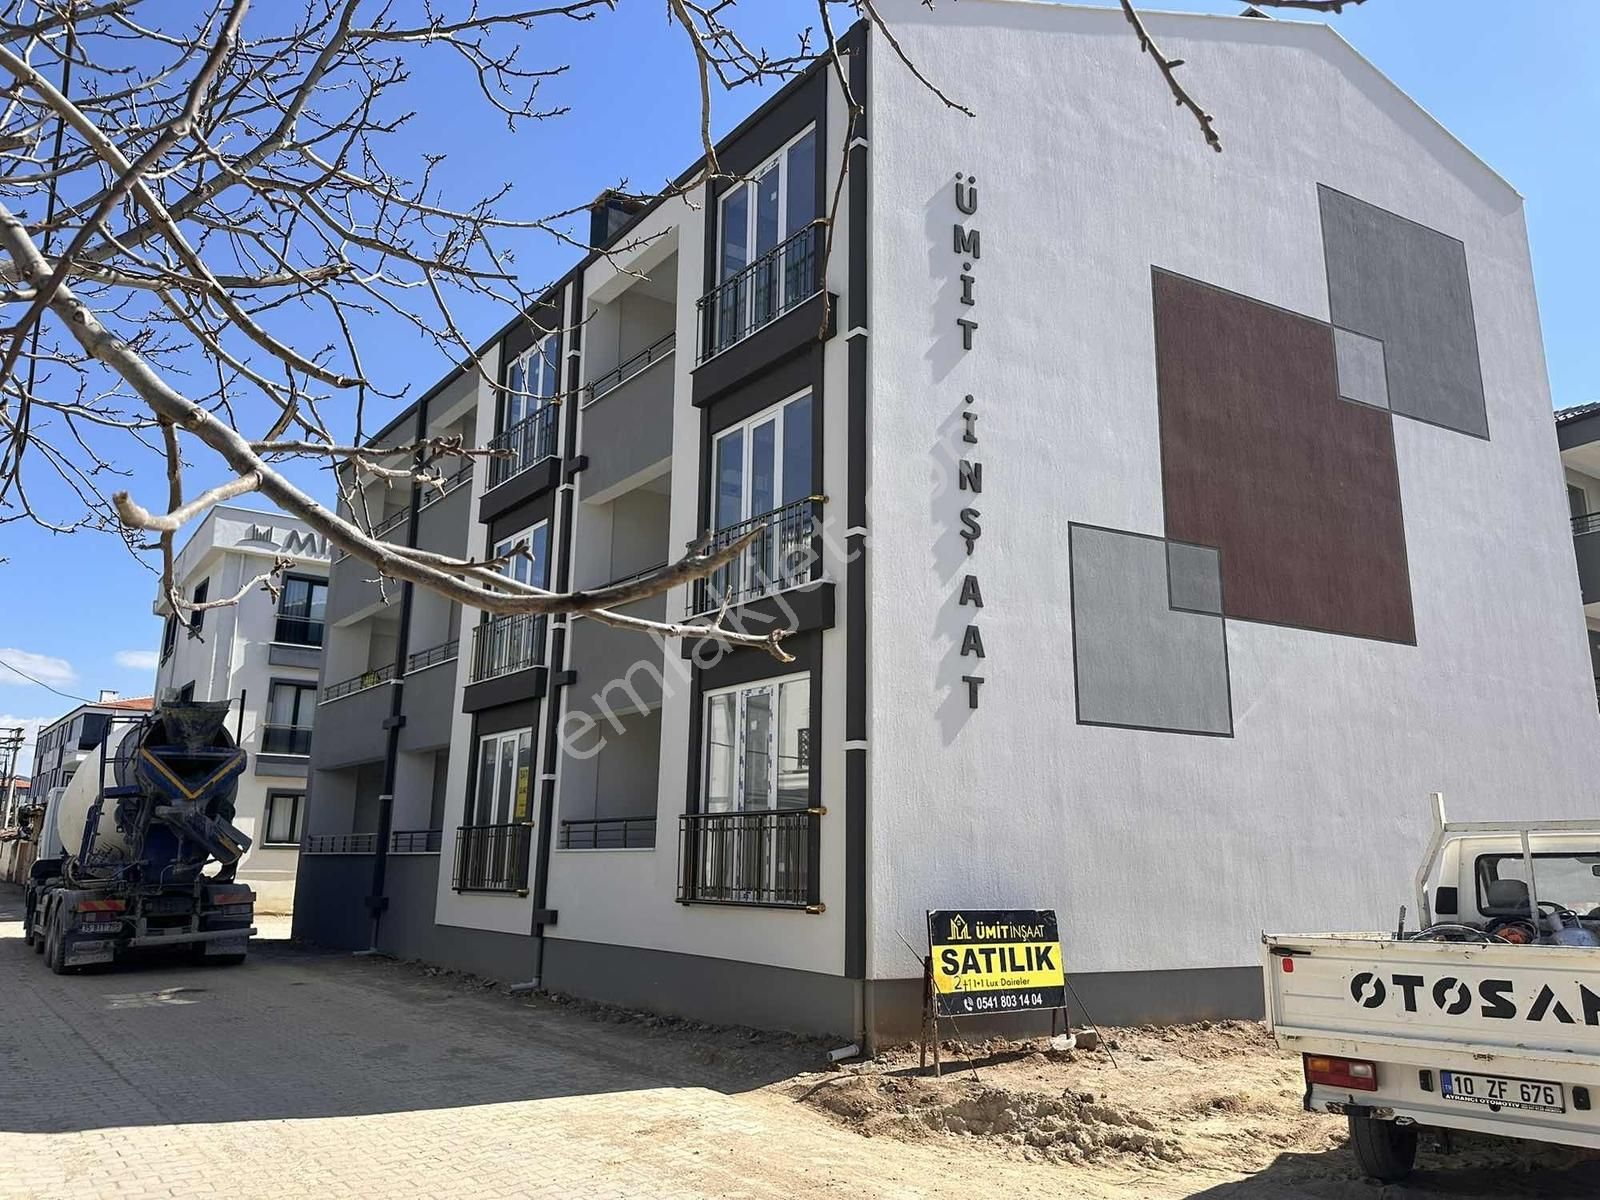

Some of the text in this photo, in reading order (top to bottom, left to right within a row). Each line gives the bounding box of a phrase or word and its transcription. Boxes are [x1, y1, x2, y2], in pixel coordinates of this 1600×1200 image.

[953, 171, 986, 710] ÜMİT İNŞAAT
[941, 945, 1056, 976] SATILIK
[985, 978, 999, 988] Lux
[1000, 977, 1030, 987] Daireler
[976, 993, 1043, 1010] 0541 803 14 04
[1454, 1076, 1474, 1095] 10
[1486, 1079, 1508, 1099] ZF
[1520, 1084, 1554, 1105] 676
